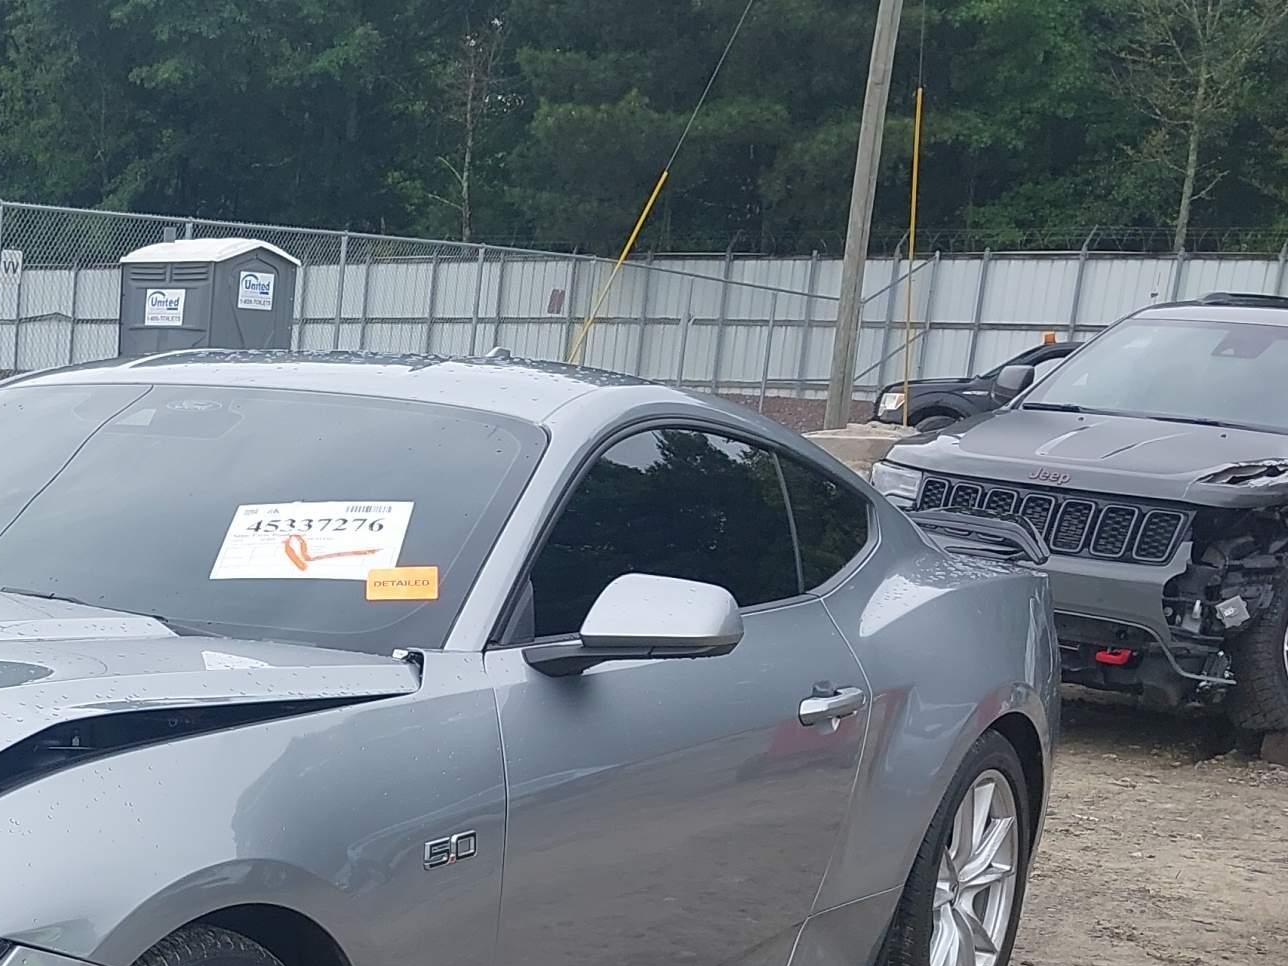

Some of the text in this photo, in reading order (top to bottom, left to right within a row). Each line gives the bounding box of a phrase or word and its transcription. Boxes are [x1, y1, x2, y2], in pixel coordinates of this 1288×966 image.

[244, 279, 271, 291] United
[151, 296, 180, 307] United
[1028, 467, 1071, 486] Jeep
[246, 518, 386, 533] 45337276
[373, 579, 430, 588] DETAILED
[424, 829, 478, 871] 5.0
